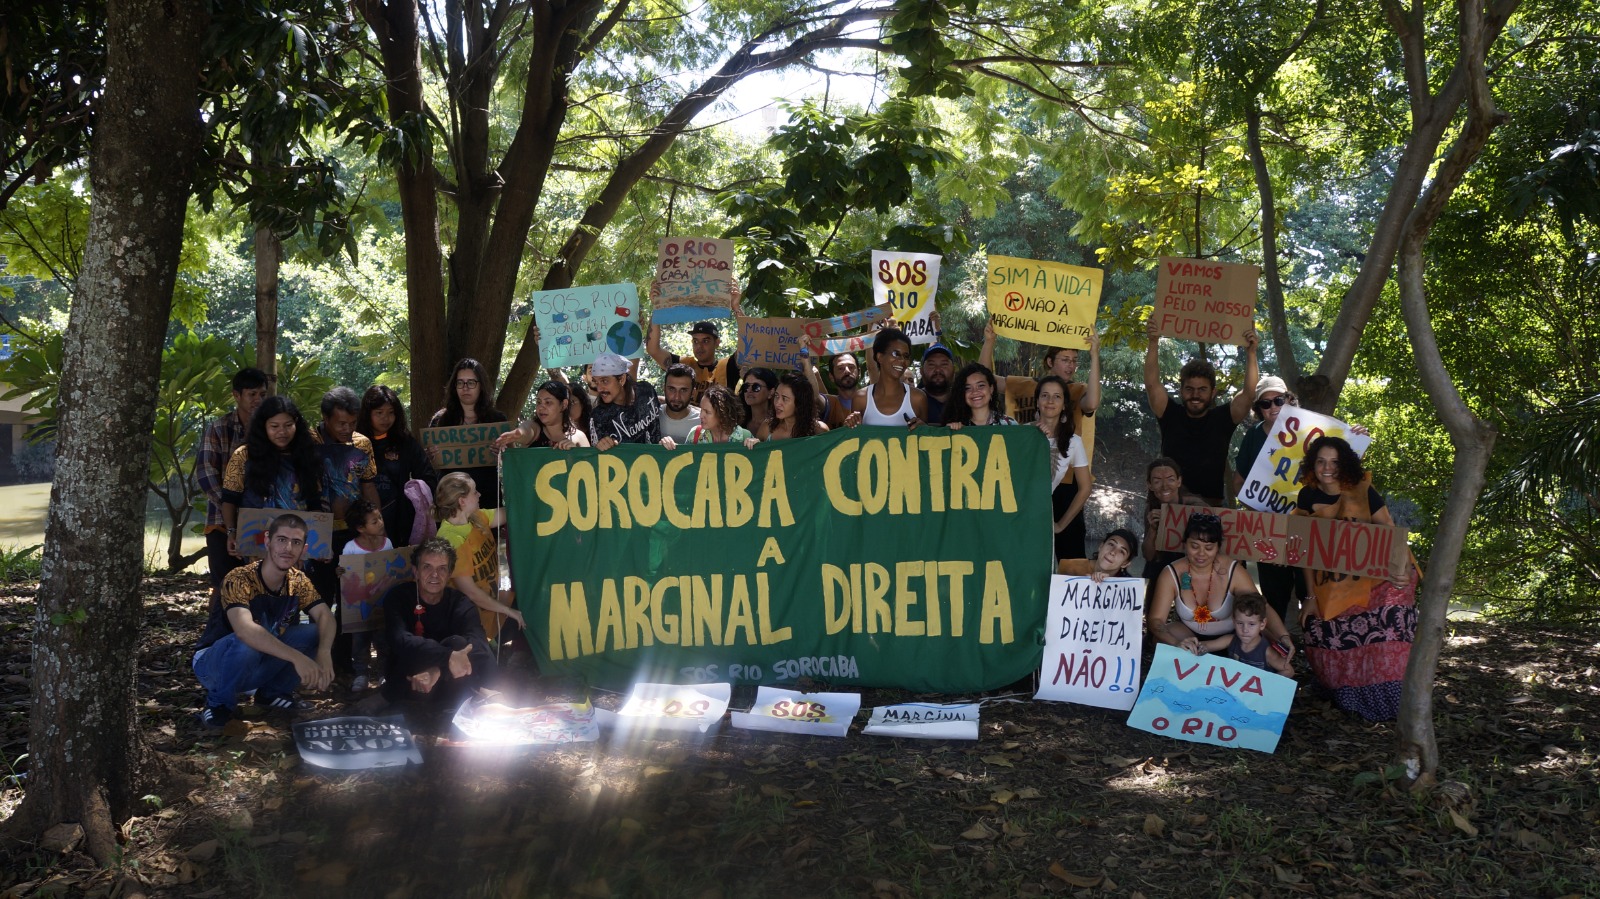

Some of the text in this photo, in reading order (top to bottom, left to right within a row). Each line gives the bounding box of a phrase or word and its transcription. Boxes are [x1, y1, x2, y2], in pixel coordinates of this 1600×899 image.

[665, 240, 717, 256] O RIO
[662, 257, 681, 269] DE
[1168, 262, 1223, 280] VAMOS
[661, 270, 689, 281] CABA
[879, 260, 927, 286] SOS
[991, 265, 1092, 296] SIM À VIDA
[1169, 280, 1212, 297] LUTAR
[539, 291, 627, 315] SOS RIO
[888, 290, 918, 309] RIO
[1025, 297, 1068, 316] NÃO À
[1163, 295, 1251, 318] PELO NOSSO
[746, 322, 790, 336] MARGINAL
[805, 322, 822, 338] O
[990, 312, 1040, 332] MARGINAL
[1161, 313, 1233, 340] FUTURO
[778, 335, 802, 345] DIRE
[806, 337, 865, 356] VIVA
[541, 341, 595, 360] SALVEM
[441, 448, 463, 466] DE
[535, 433, 1018, 537] SOROCABA CONTRA
[1245, 480, 1297, 515] SOROC
[1307, 519, 1394, 577] NÃO!!!
[549, 560, 1015, 660] MARGINAL DIREITA
[679, 654, 860, 682] SOS RIO SOROCABA
[1174, 658, 1264, 696] VIVA
[771, 700, 826, 718] SOS
[304, 729, 402, 738] DIREITA
[1152, 717, 1237, 741] O RIO
